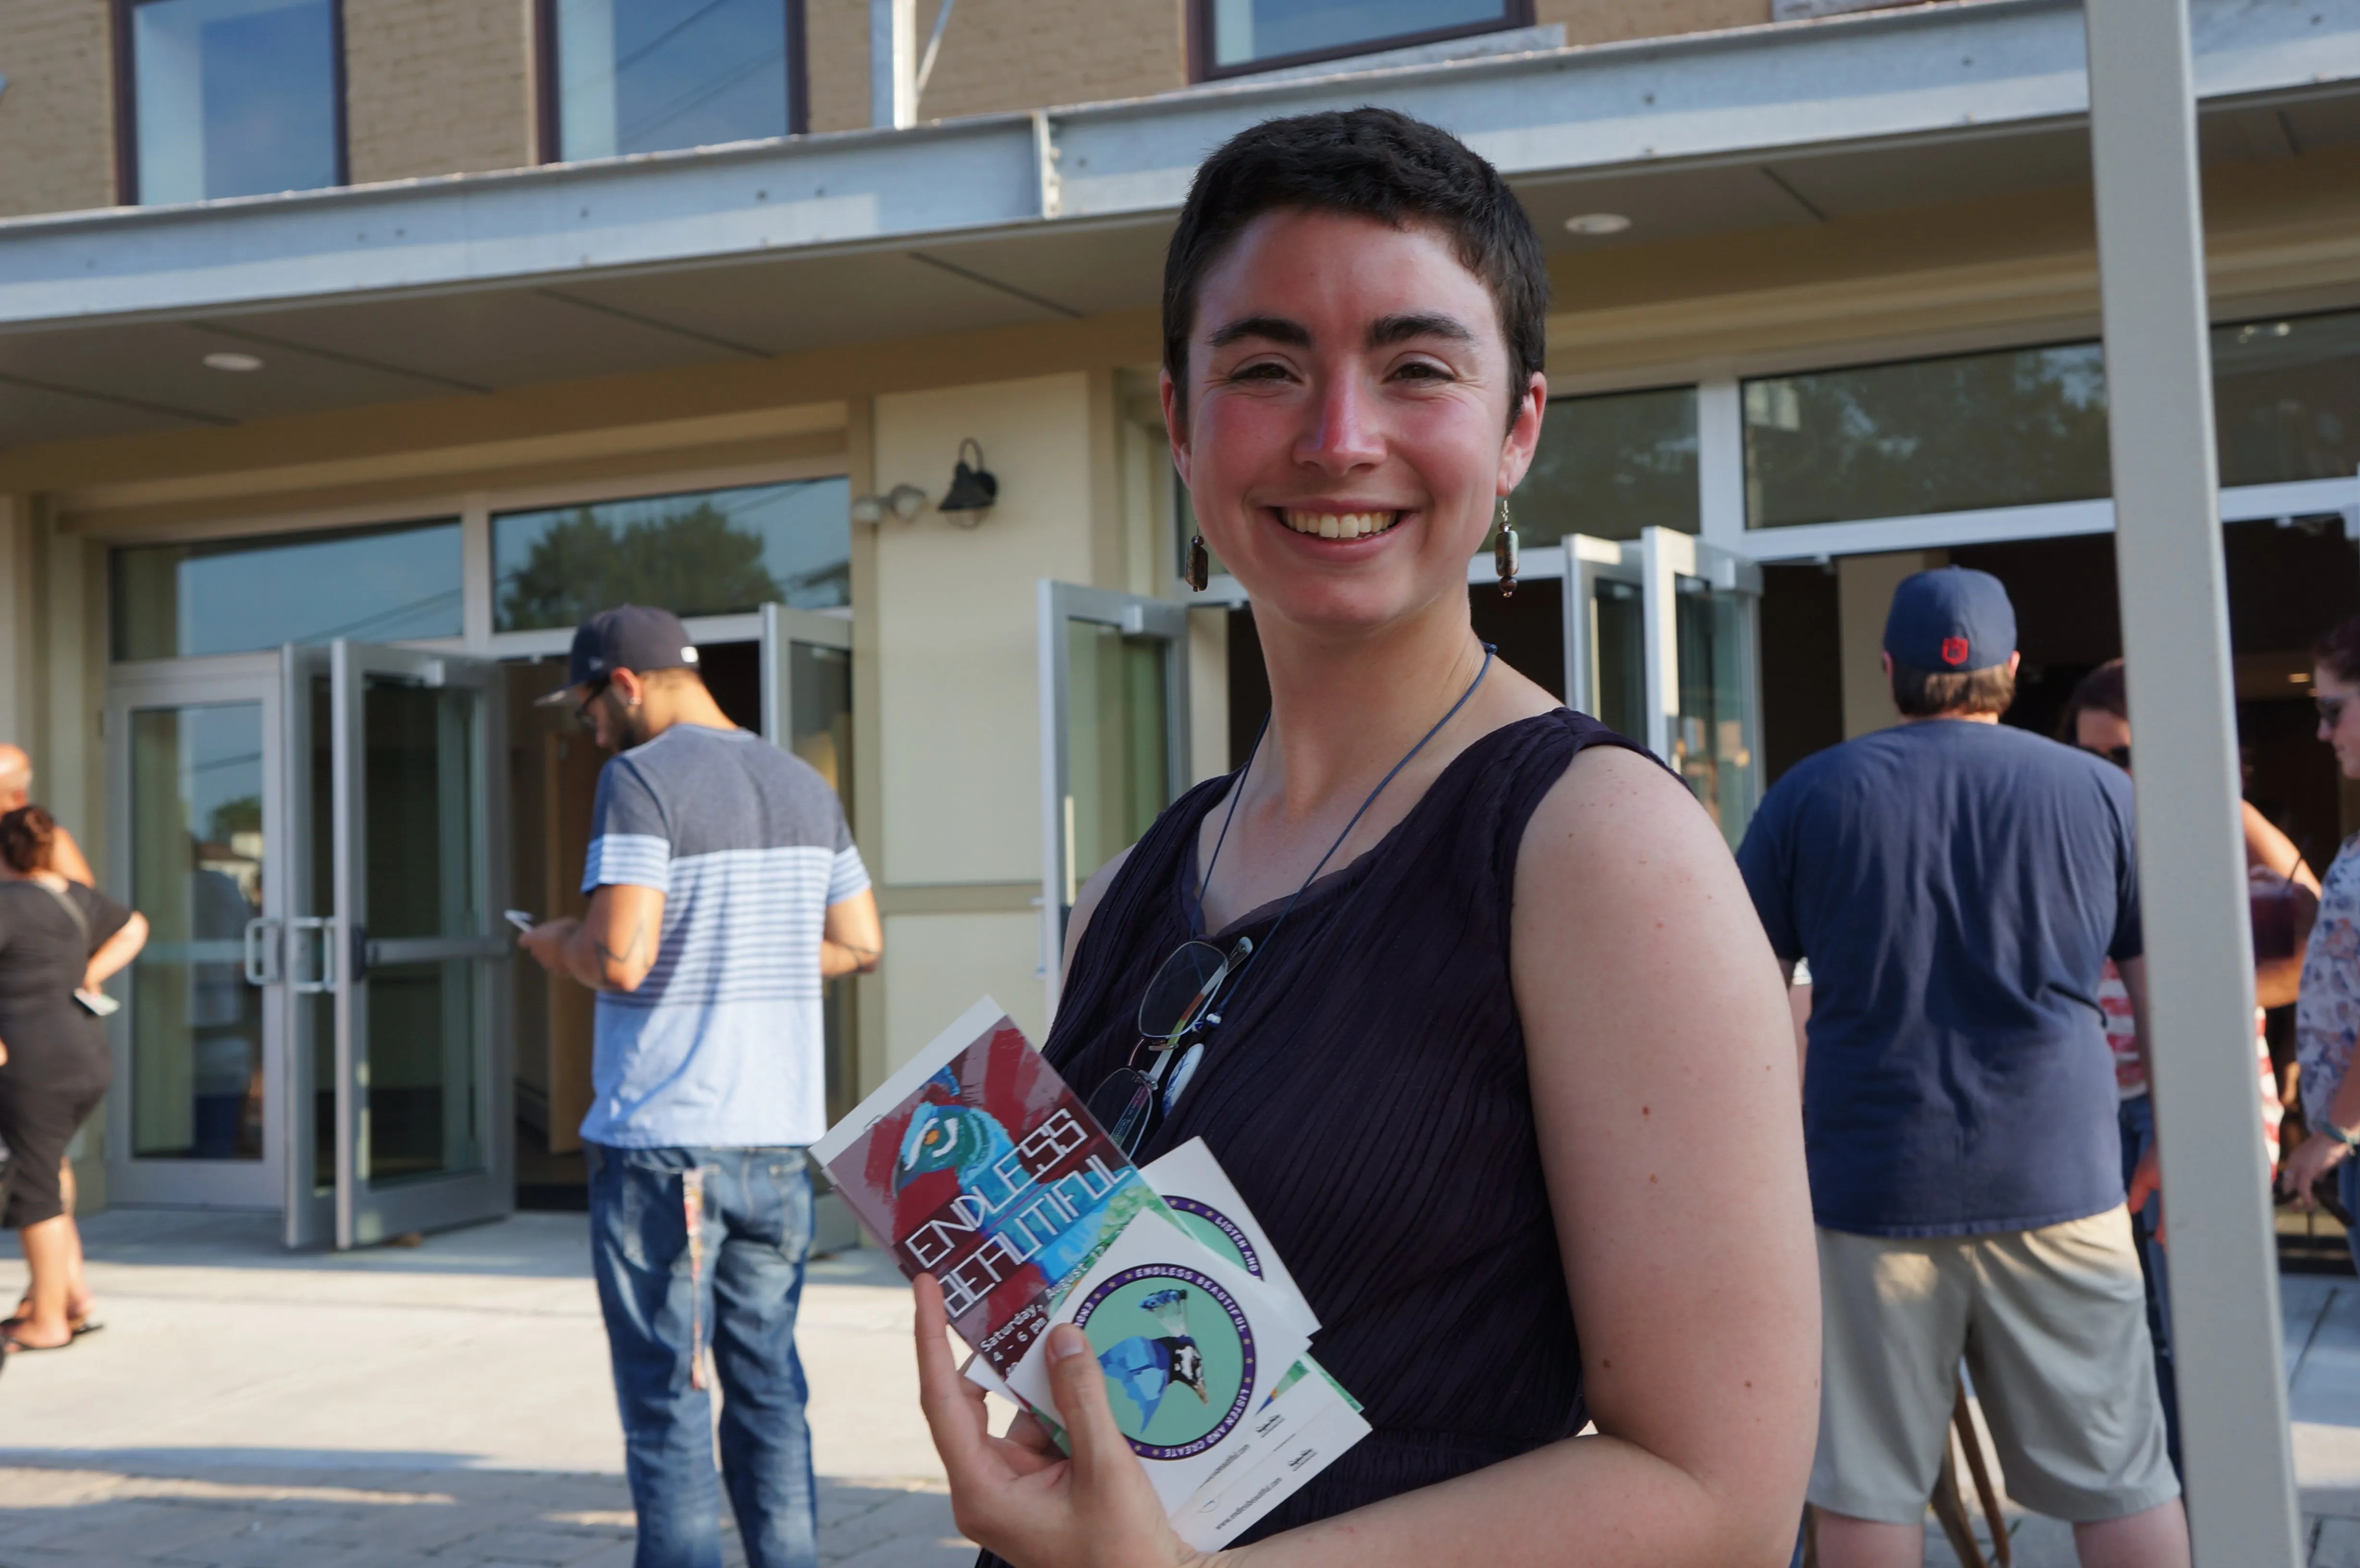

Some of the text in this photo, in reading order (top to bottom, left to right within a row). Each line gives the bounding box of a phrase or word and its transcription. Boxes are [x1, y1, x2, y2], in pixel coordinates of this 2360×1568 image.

[905, 1108, 1089, 1268] ENDLESS
[938, 1154, 1131, 1318] BEAUTIFUL
[1215, 1216, 1259, 1271] LISTEN AND
[980, 1304, 1044, 1352] Saturday,
[1045, 1262, 1089, 1300] August
[1135, 1267, 1247, 1333] ENDLESS BEAUTIFUL
[993, 1351, 1004, 1362] 4
[1017, 1331, 1029, 1342] 6
[1029, 1317, 1048, 1335] pm
[1224, 1388, 1250, 1426] LISTEN
[1164, 1440, 1205, 1458] CREATE
[1205, 1426, 1226, 1444] AND
